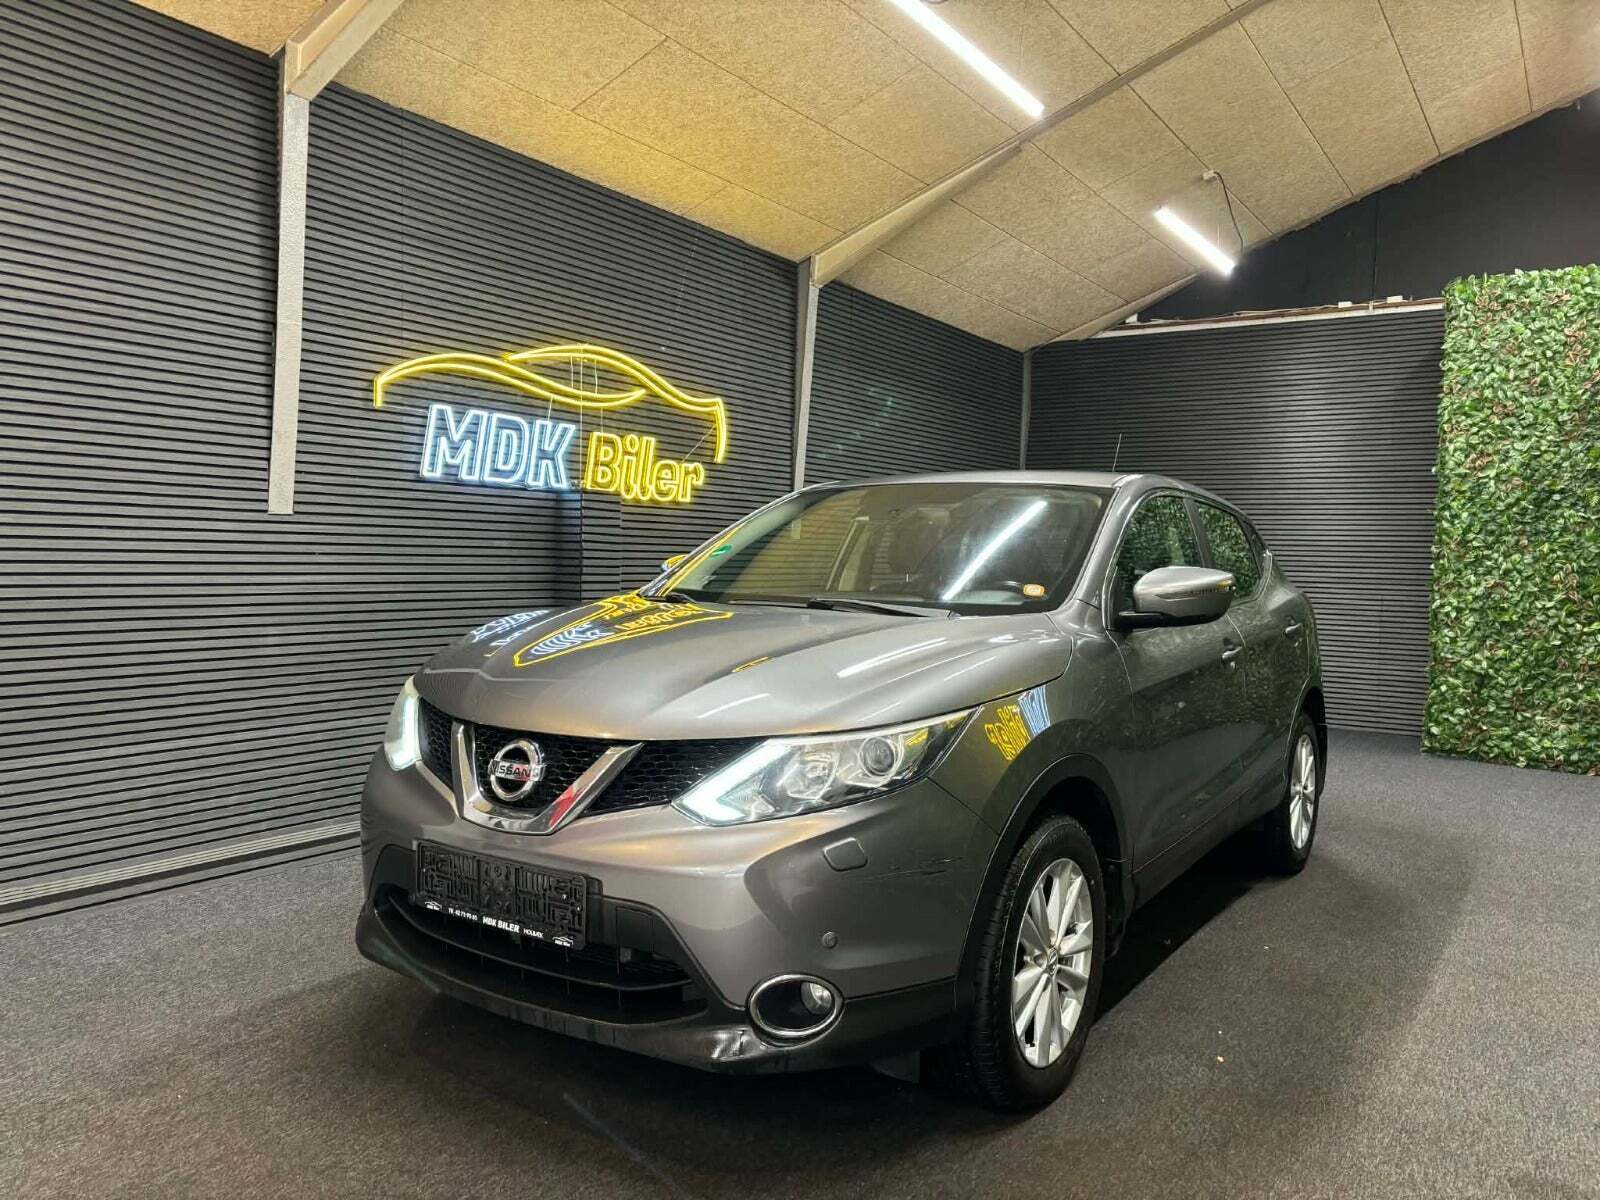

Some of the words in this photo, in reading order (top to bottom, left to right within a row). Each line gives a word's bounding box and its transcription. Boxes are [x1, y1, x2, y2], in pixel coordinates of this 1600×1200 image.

[421, 403, 576, 490] MDK
[583, 431, 705, 503] Biler
[490, 757, 532, 778] NISSAN
